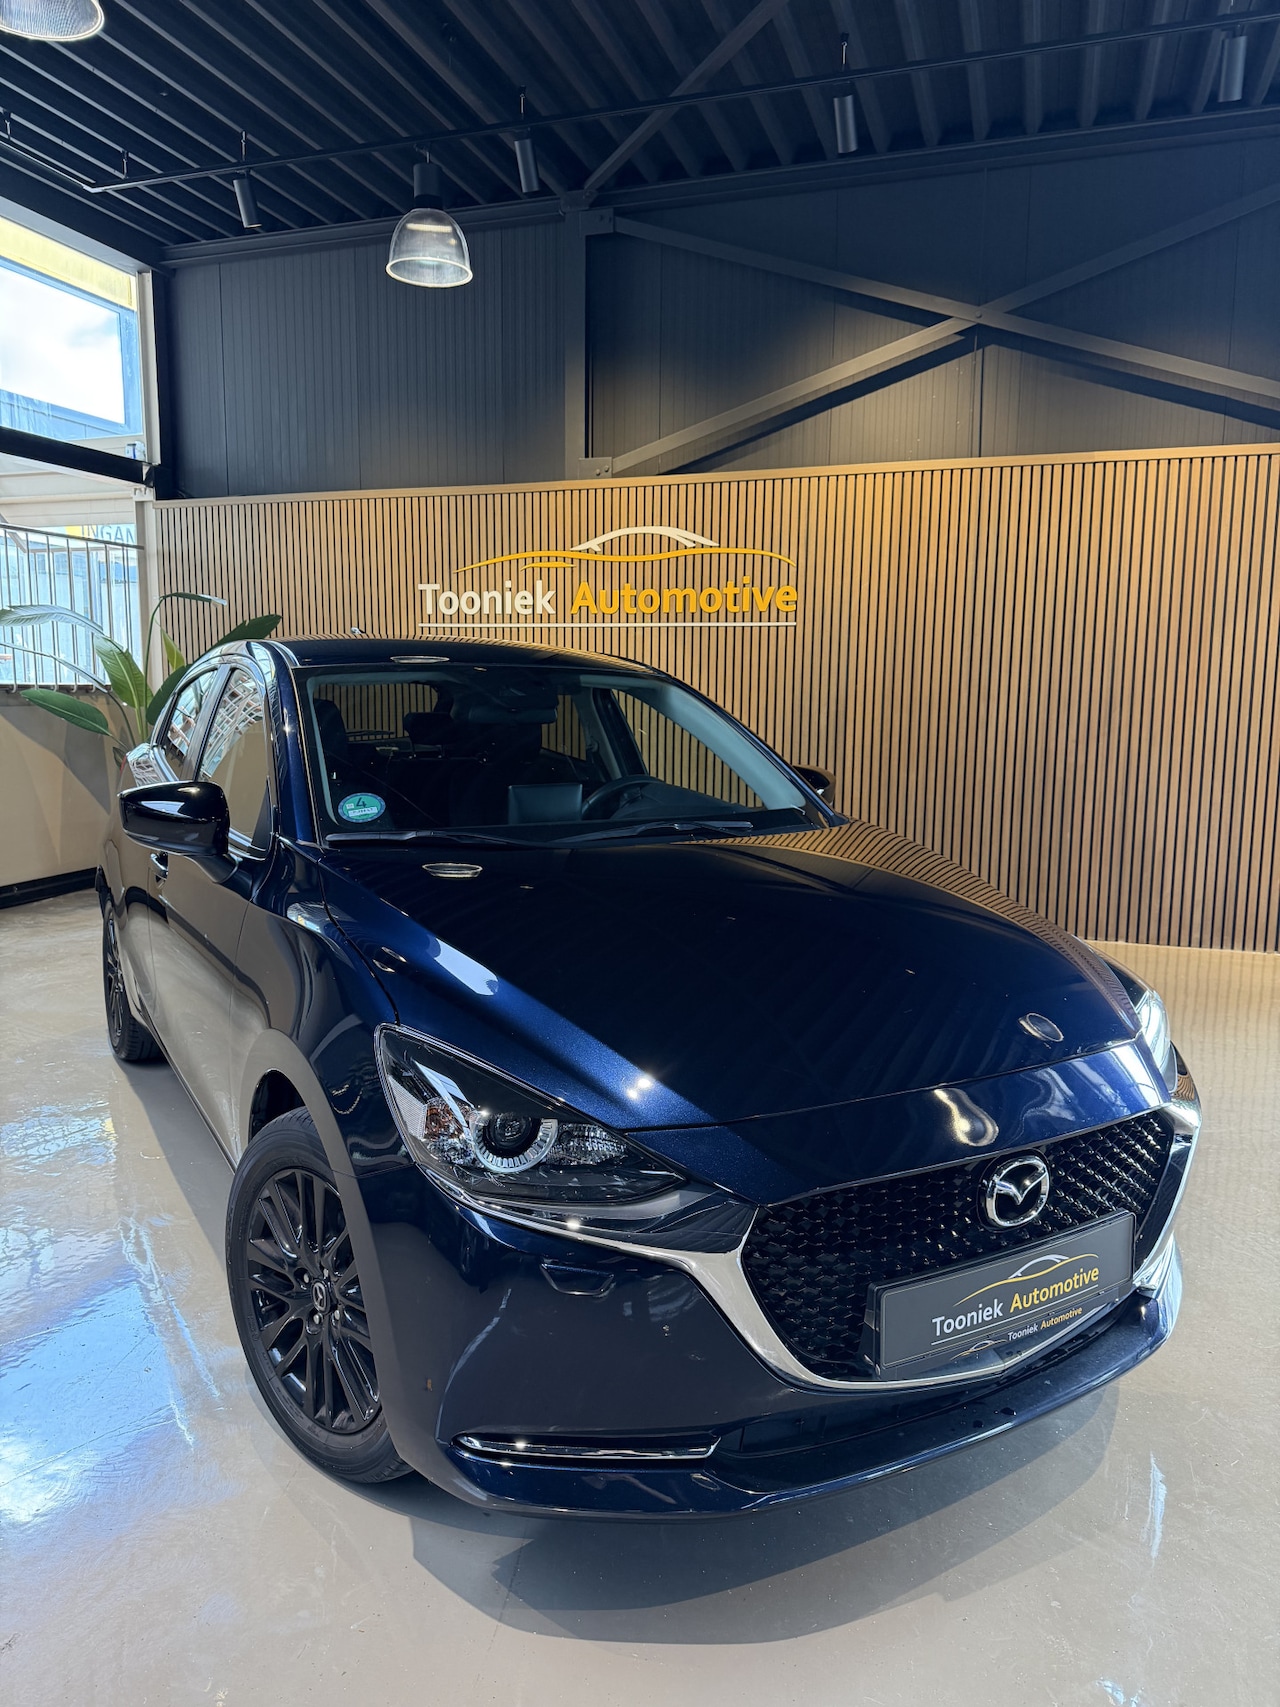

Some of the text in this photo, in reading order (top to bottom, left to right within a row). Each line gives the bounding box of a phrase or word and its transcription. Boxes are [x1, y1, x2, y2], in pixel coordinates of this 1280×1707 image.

[418, 576, 797, 615] Tooniek Automotive
[932, 1267, 1099, 1336] Tooniek Automotive
[1008, 1307, 1082, 1341] Tooniek Automotive
